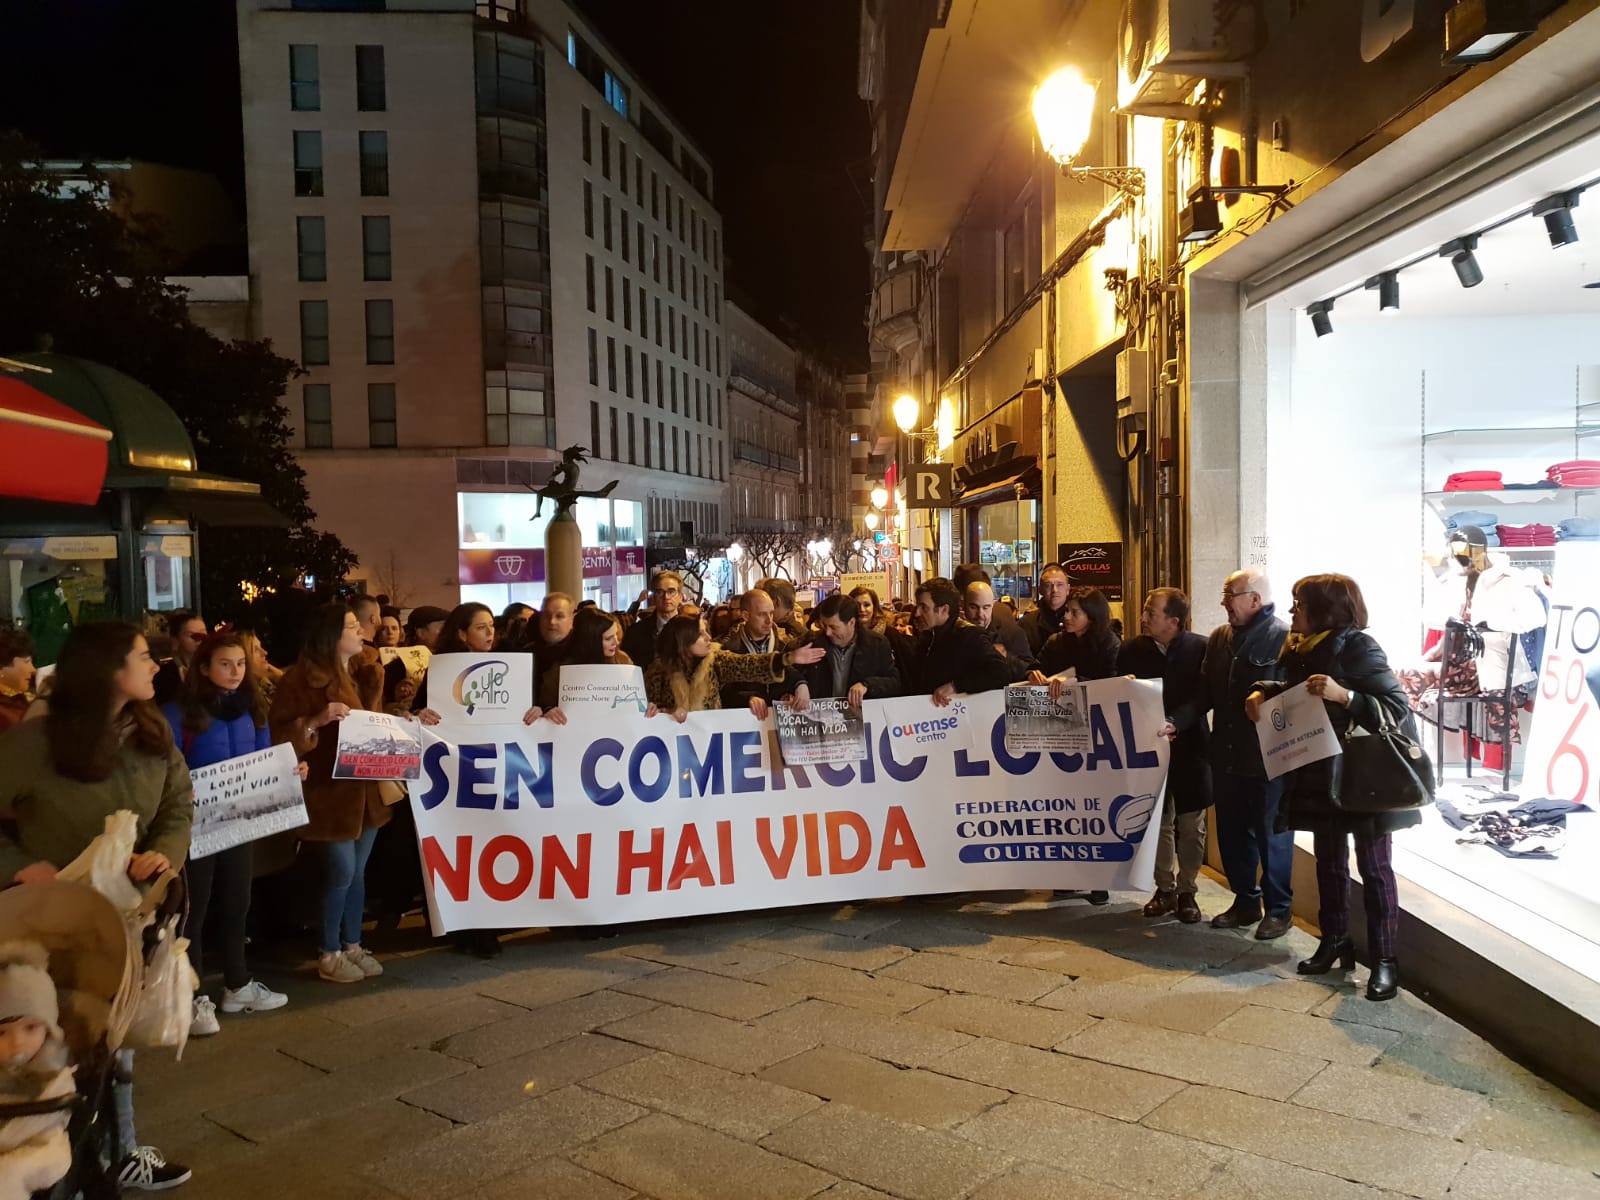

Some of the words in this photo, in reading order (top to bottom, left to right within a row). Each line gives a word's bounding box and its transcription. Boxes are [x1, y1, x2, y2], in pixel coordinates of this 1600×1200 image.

[916, 473, 942, 500] R
[1070, 563, 1111, 571] CASILLAS
[562, 683, 586, 692] Centro
[586, 683, 620, 692] Comercial
[778, 716, 808, 726] LOCAL
[801, 726, 817, 736] HAI
[822, 723, 848, 734] VIDA
[892, 716, 958, 738] ourense
[915, 731, 947, 743] centro
[191, 767, 217, 780] Sen
[219, 751, 275, 773] Comercio
[210, 771, 247, 790] Local
[420, 741, 554, 811] SEN
[192, 796, 218, 808] Non
[224, 784, 245, 799] hai
[251, 775, 279, 790] Vida
[955, 798, 1076, 816] FEDERACION
[1084, 797, 1102, 811] DE
[956, 817, 1106, 839] COMERCIO
[421, 833, 592, 903] NON
[616, 820, 736, 896] HAI
[755, 805, 926, 881] VIDA
[983, 845, 1105, 860] OURENSE
